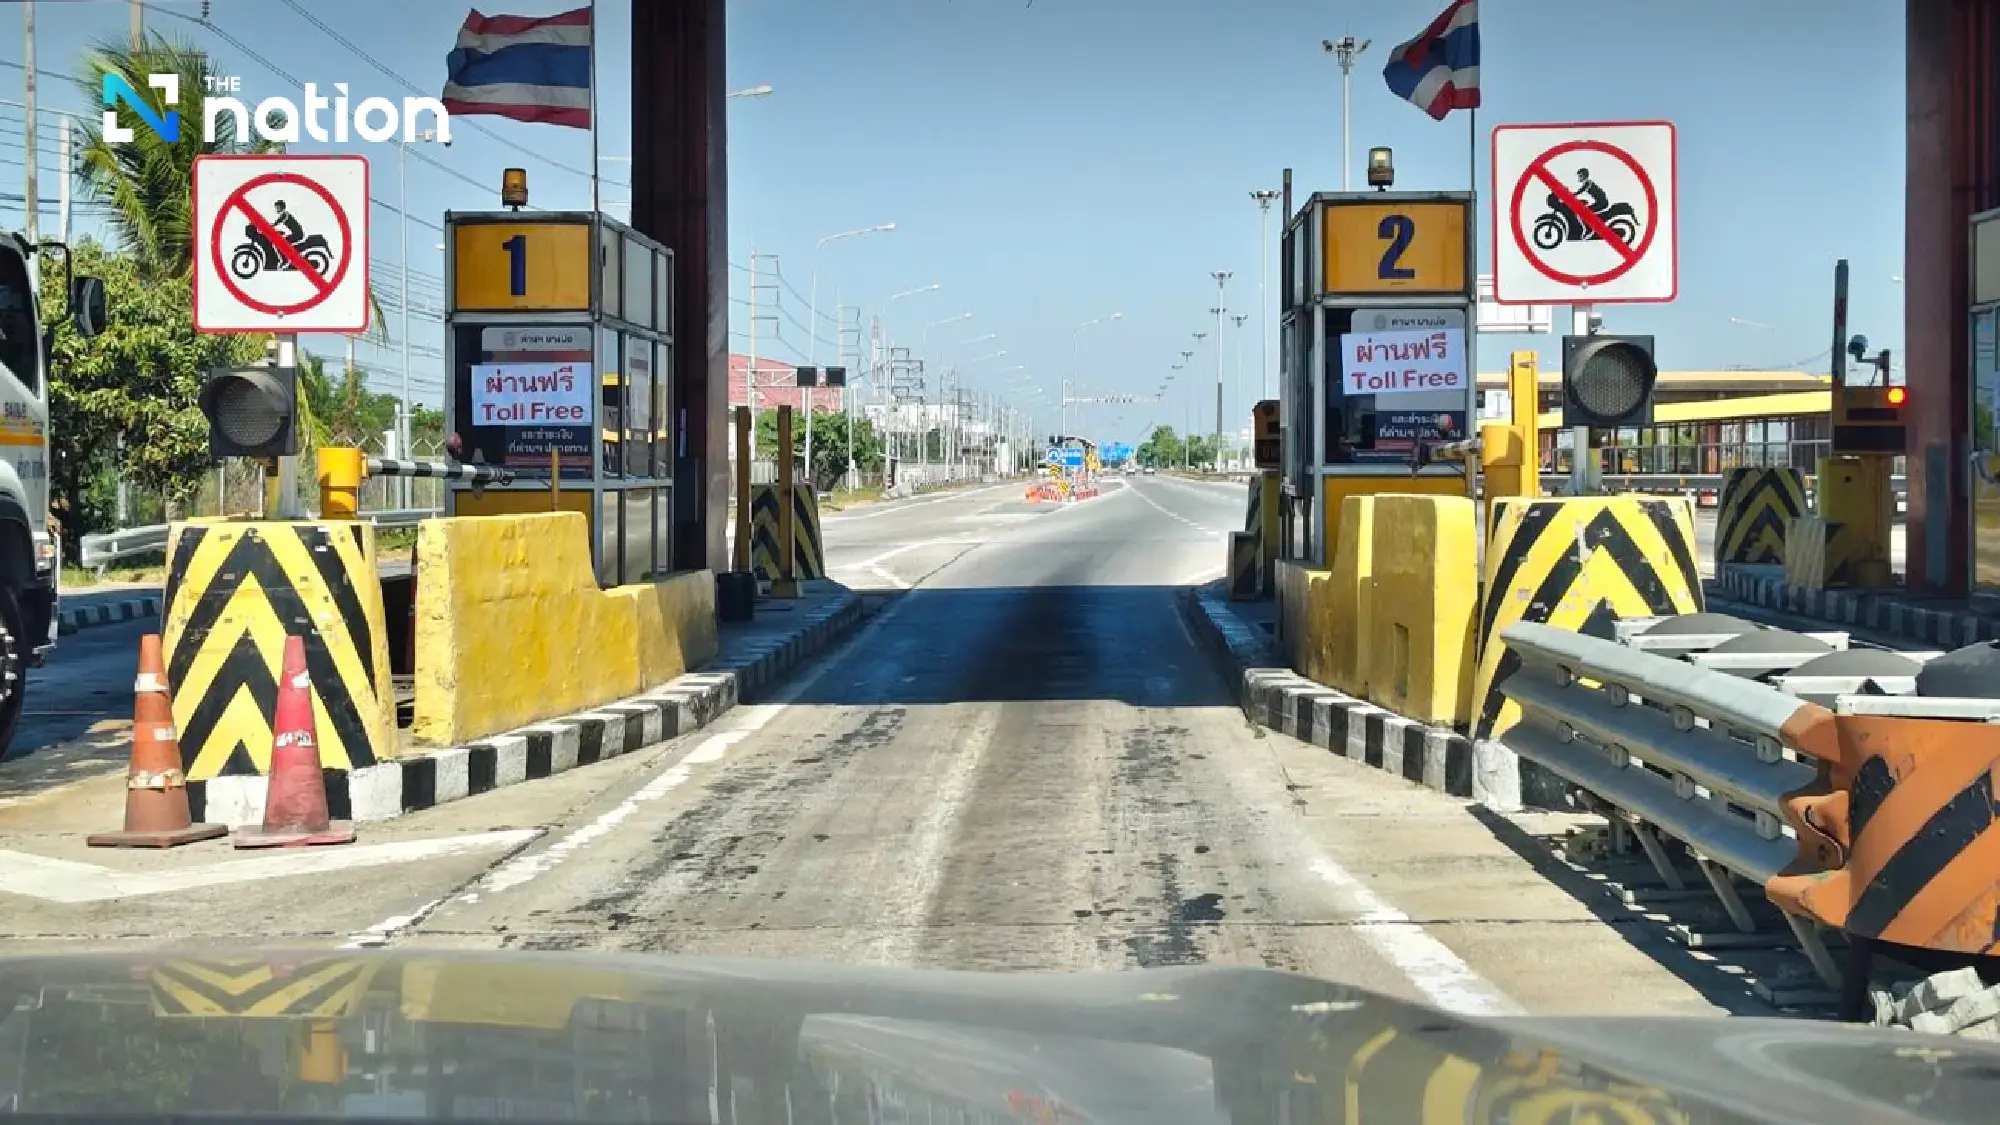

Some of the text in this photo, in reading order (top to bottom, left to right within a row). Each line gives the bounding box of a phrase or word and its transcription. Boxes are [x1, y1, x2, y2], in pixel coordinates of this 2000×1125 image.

[1377, 214, 1416, 280] 2
[501, 234, 527, 296] 1
[1356, 331, 1447, 363] ผ่านฟรี
[485, 365, 575, 393] ผ่านฟรี
[1351, 368, 1459, 390] Toll Free
[481, 402, 584, 421] Toll Free
